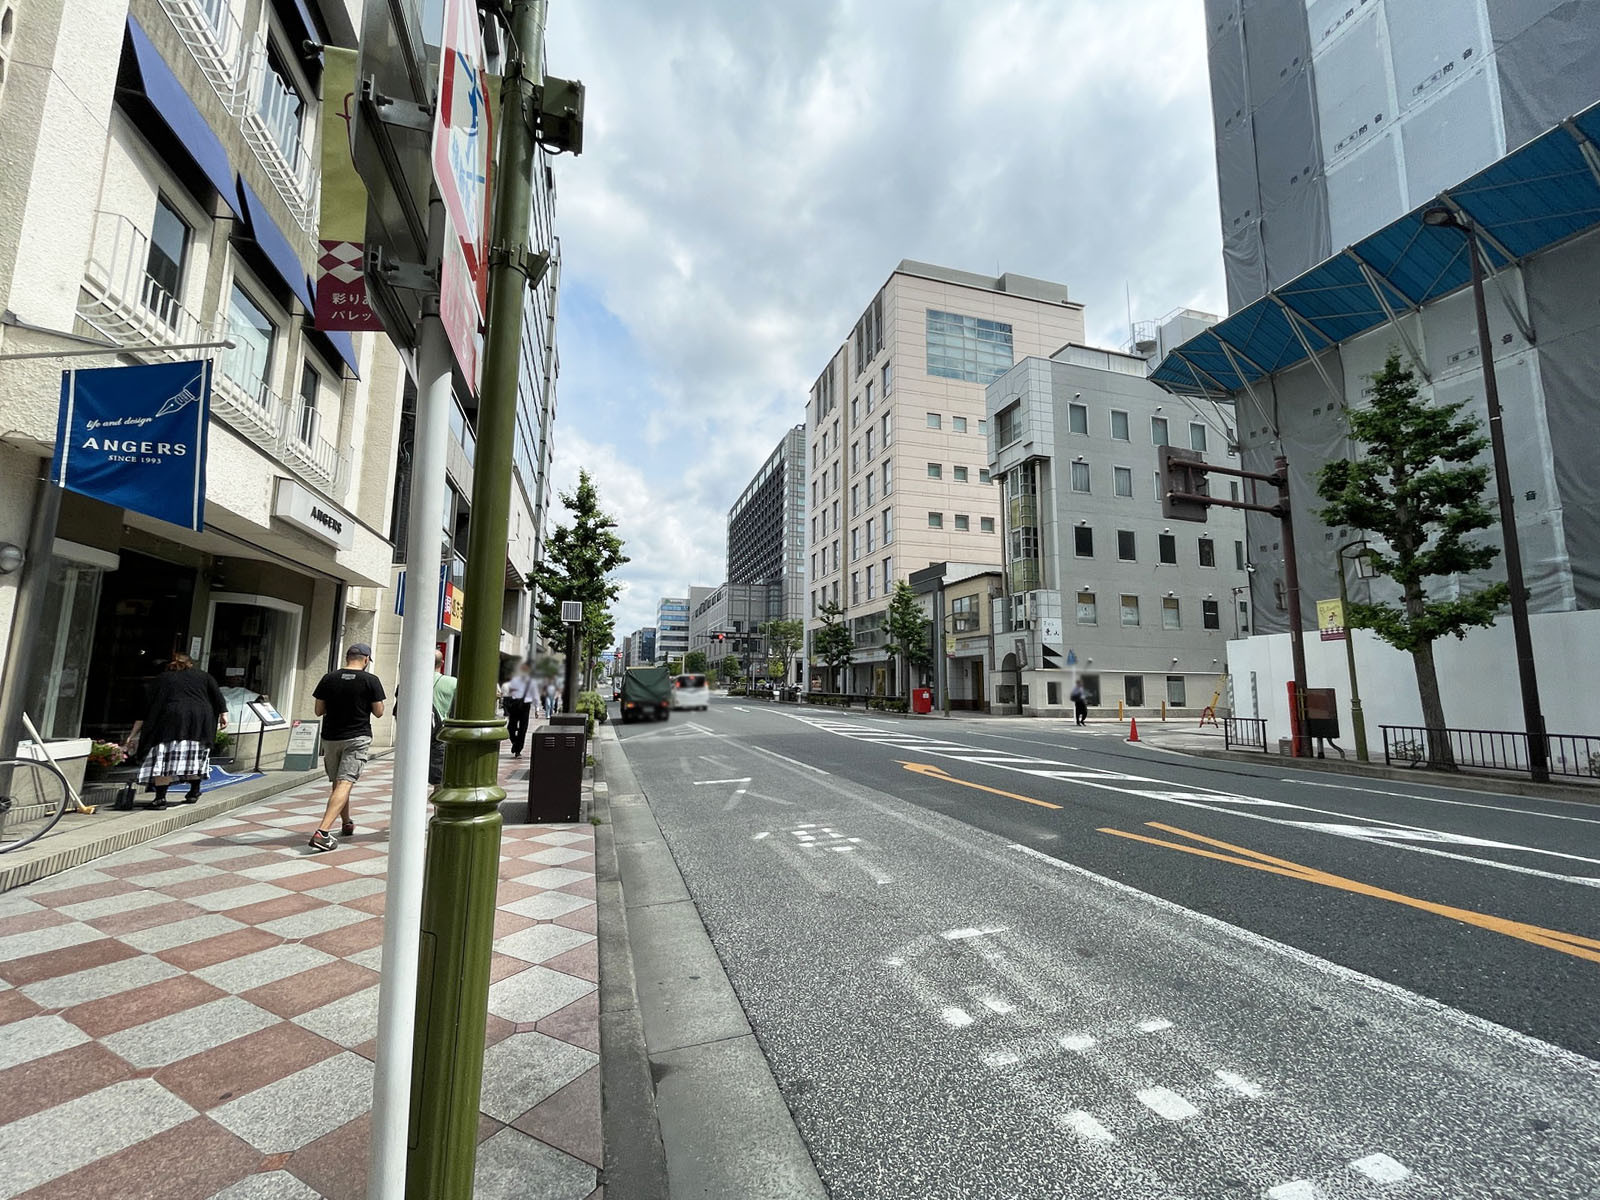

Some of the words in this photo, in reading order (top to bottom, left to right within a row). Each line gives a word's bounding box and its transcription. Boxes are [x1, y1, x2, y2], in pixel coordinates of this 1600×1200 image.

[86, 420, 101, 431] life
[103, 417, 122, 427] and
[124, 417, 152, 427] design
[82, 437, 187, 456] ANGERS
[108, 454, 137, 463] SINCE
[141, 455, 162, 464] 1993
[310, 505, 342, 534] ANGERS
